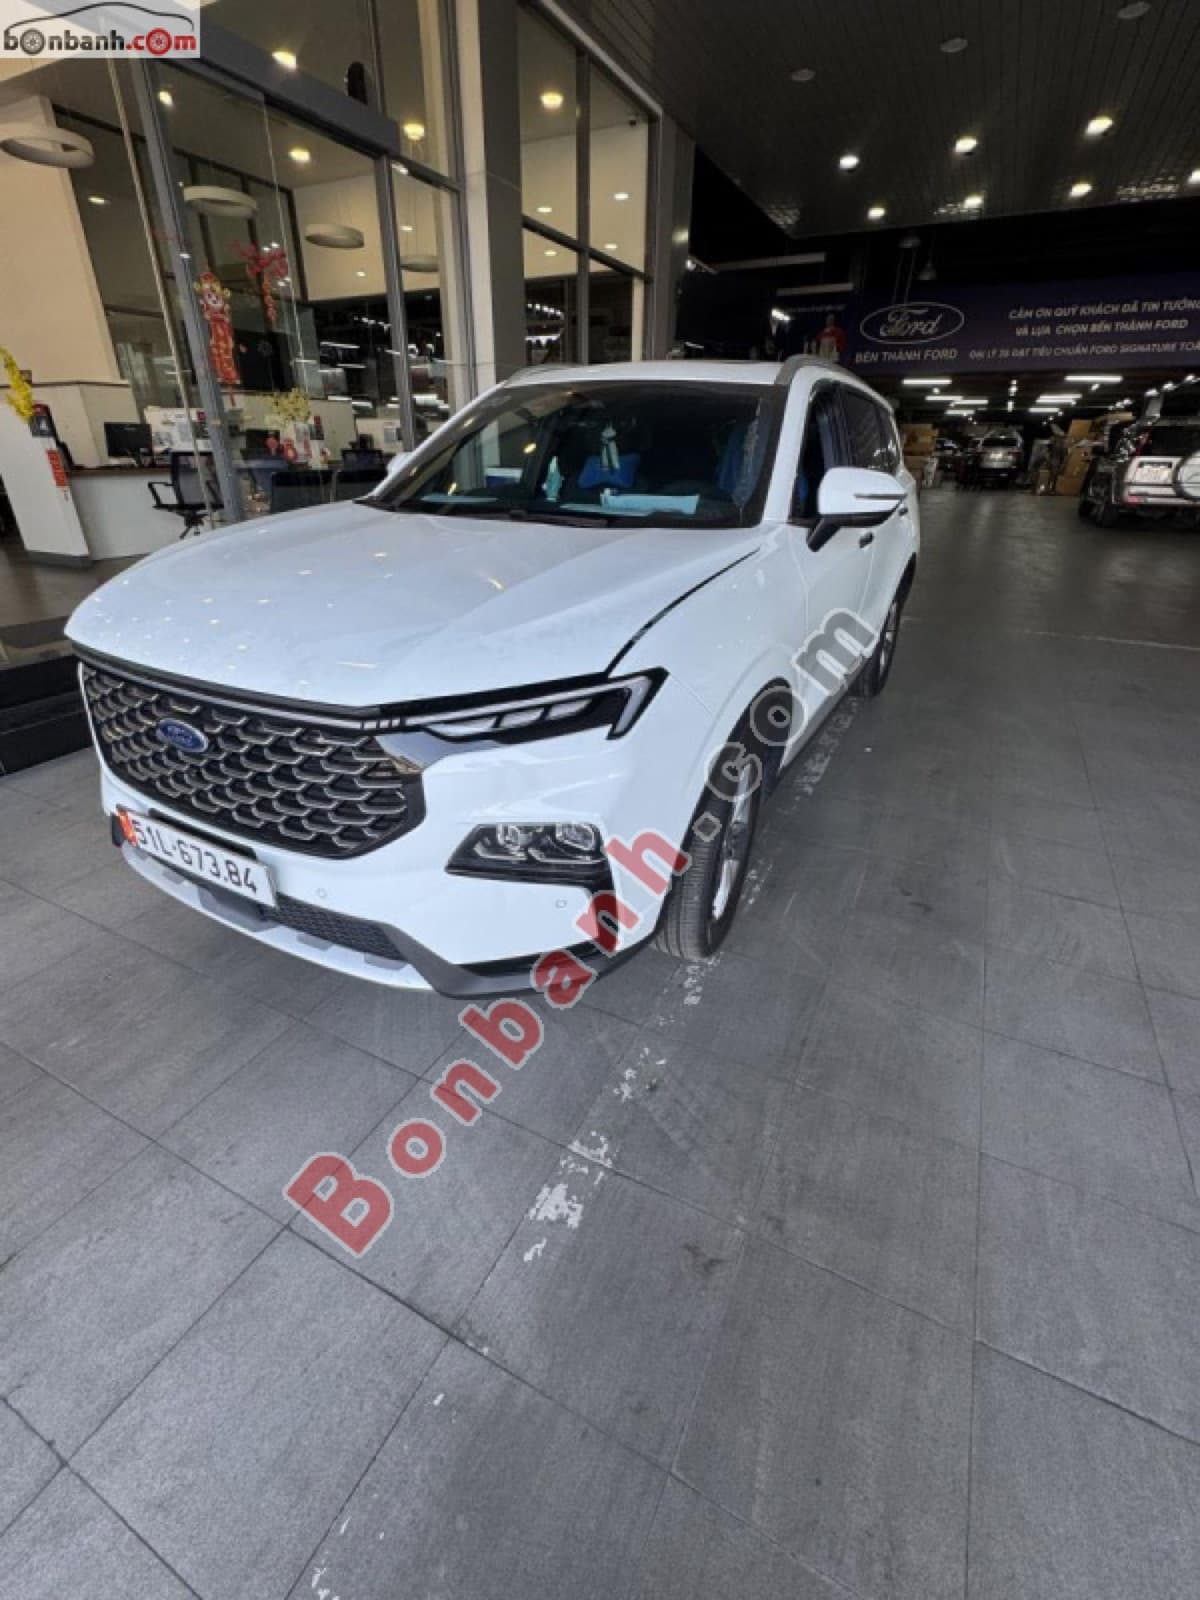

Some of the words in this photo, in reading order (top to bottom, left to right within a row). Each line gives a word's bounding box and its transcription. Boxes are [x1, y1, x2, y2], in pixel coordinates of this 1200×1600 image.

[1140, 301, 1160, 313] TIN
[879, 307, 943, 337] Ford
[1154, 318, 1189, 330] FORD
[923, 348, 959, 361] FORD
[1089, 344, 1119, 356] FORD
[131, 819, 257, 894] 51L-673.84
